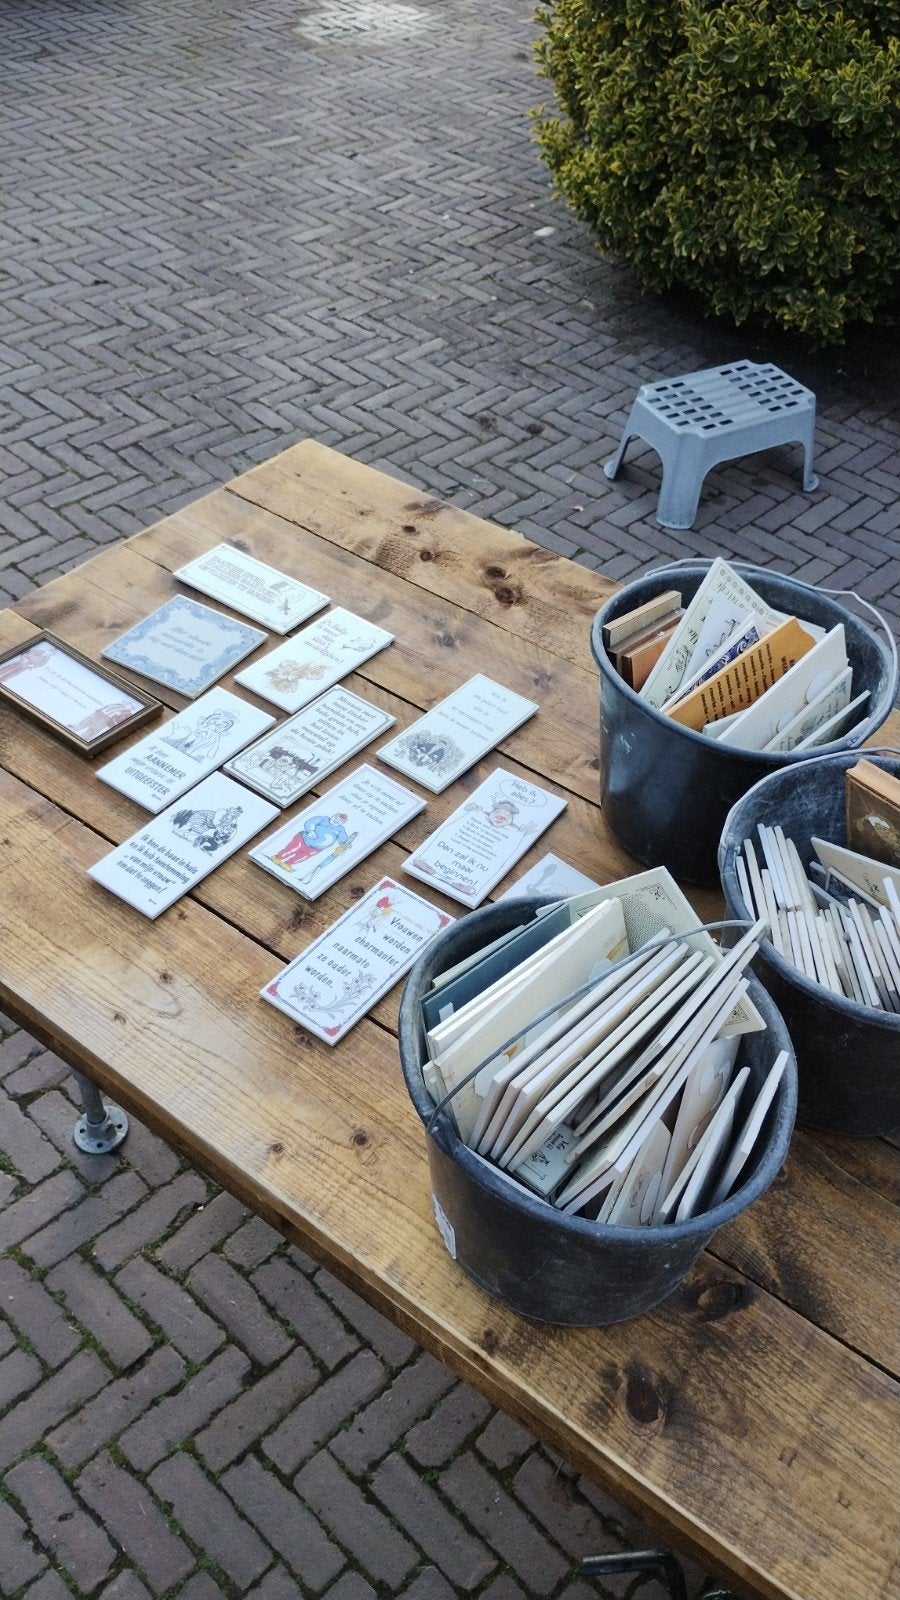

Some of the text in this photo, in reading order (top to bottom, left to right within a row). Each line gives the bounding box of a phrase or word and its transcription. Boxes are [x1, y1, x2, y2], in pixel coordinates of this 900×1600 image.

[123, 764, 171, 797] UITGEEFSTER
[143, 752, 187, 781] AANNEMER
[509, 789, 536, 806] alles?
[510, 781, 539, 798] Heb ik
[128, 841, 139, 849] en
[141, 848, 157, 860] heb
[151, 855, 191, 884] toestemming
[137, 860, 156, 874] mijn
[140, 833, 200, 874] Ik ben de baas in huis
[436, 840, 456, 853] Dan
[453, 849, 469, 861] zal
[467, 856, 478, 865] ik
[475, 862, 490, 872] nu
[450, 859, 474, 875] maar
[134, 871, 144, 879] te
[431, 858, 478, 889] beginnen!
[381, 931, 414, 954] worden
[388, 915, 426, 943] Vrouwen
[316, 952, 354, 978] ze ouder
[331, 940, 372, 969] naarmate
[353, 934, 400, 968] charmanter
[303, 962, 339, 988] worden.
